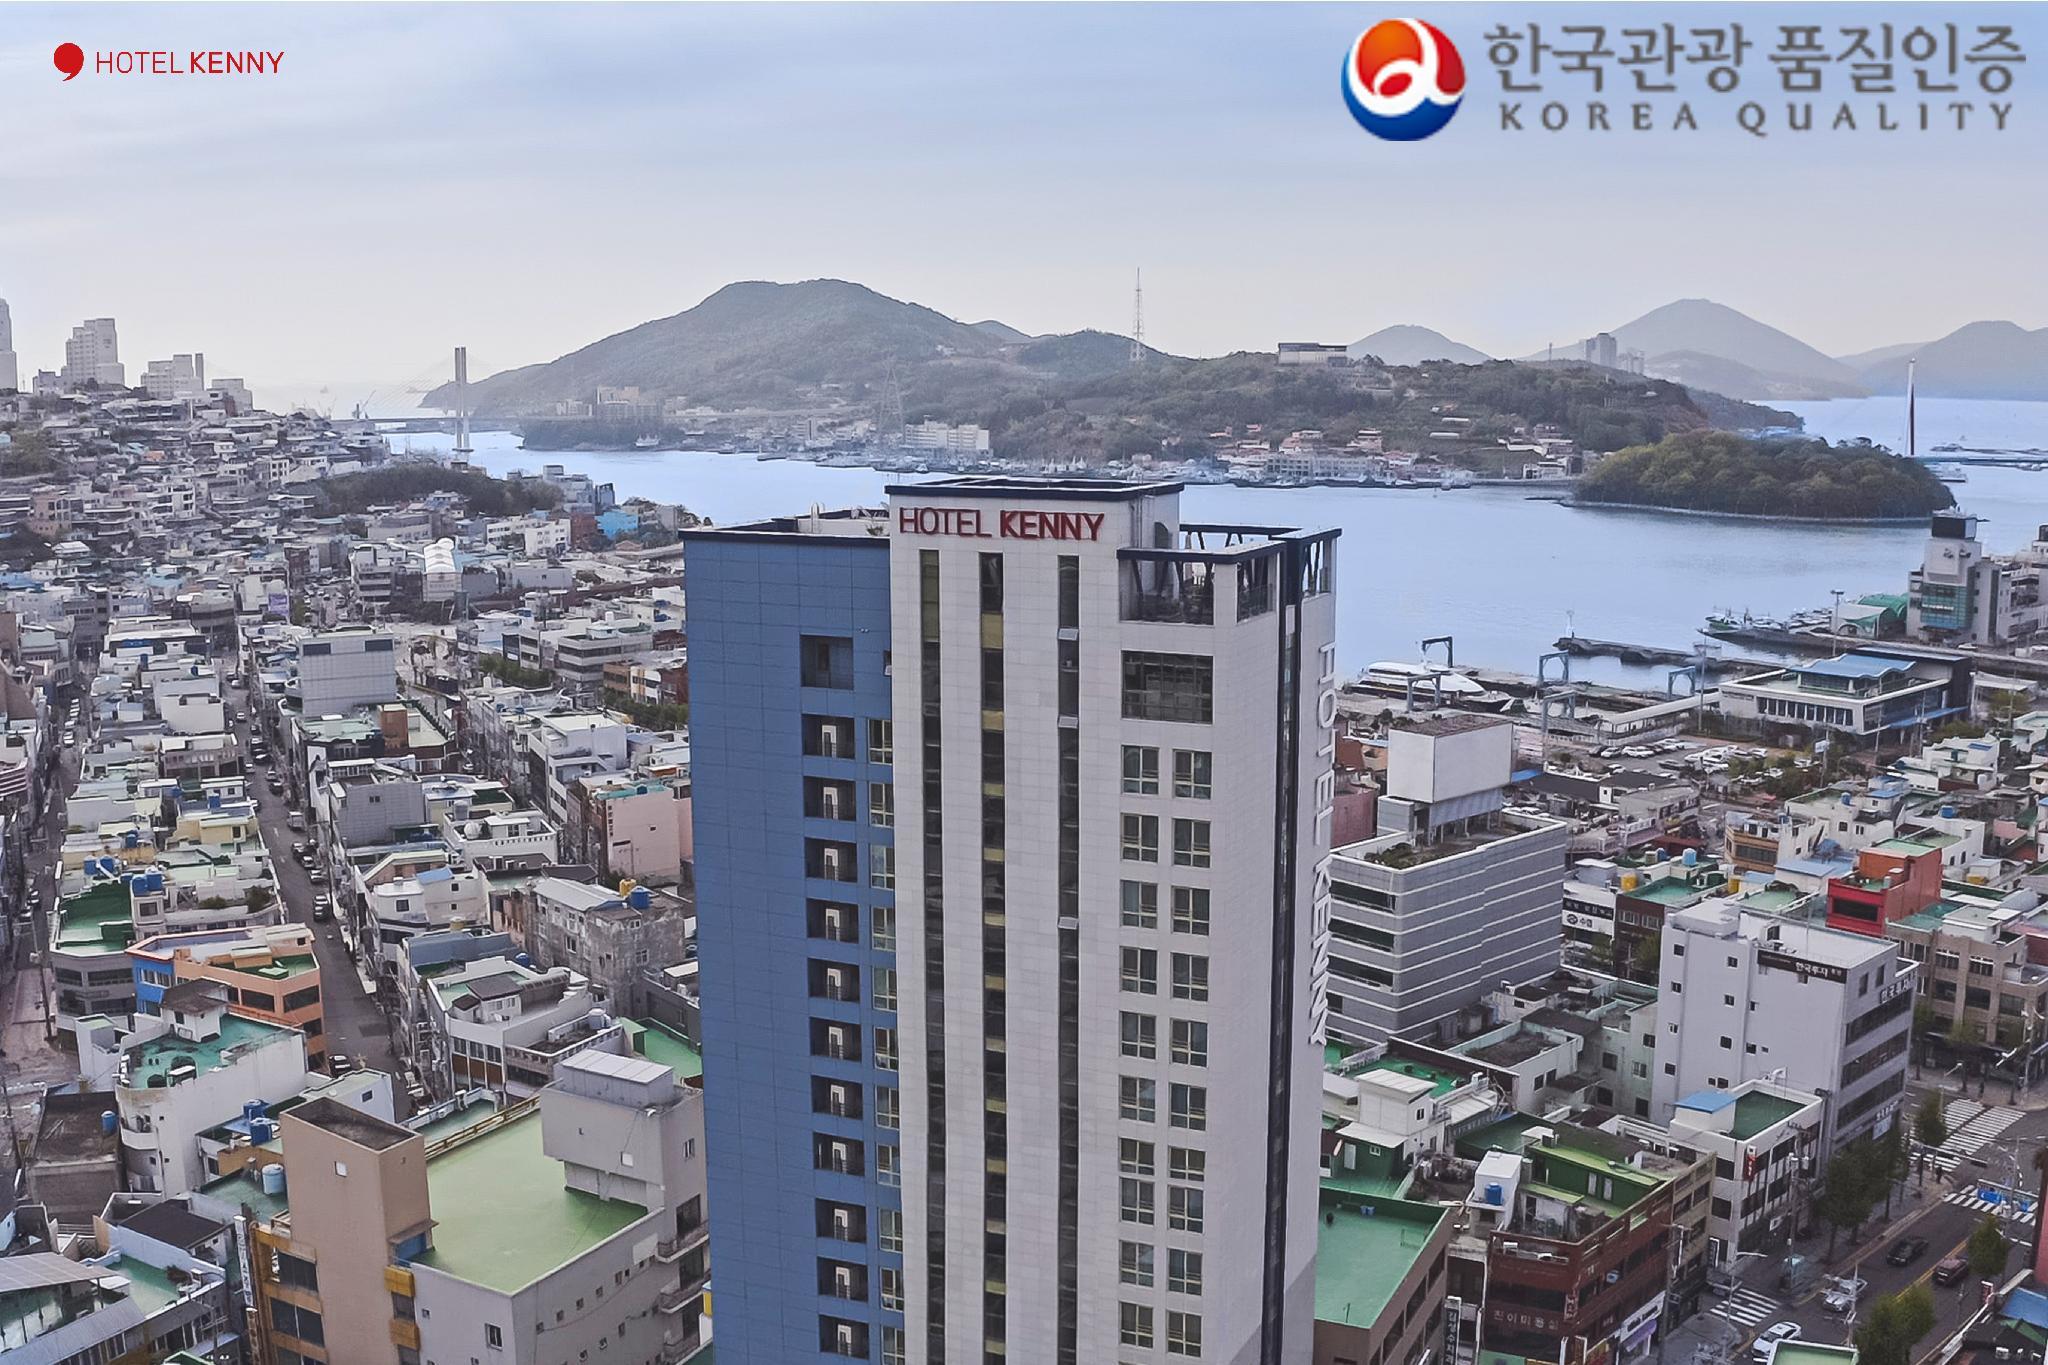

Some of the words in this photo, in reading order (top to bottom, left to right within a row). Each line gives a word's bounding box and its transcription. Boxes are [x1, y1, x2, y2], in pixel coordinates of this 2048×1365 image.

[899, 506, 992, 537] HOTEL
[1000, 509, 1105, 541] KENNY
[1314, 642, 1337, 846] HOTEL
[1309, 855, 1331, 1046] KENNY
